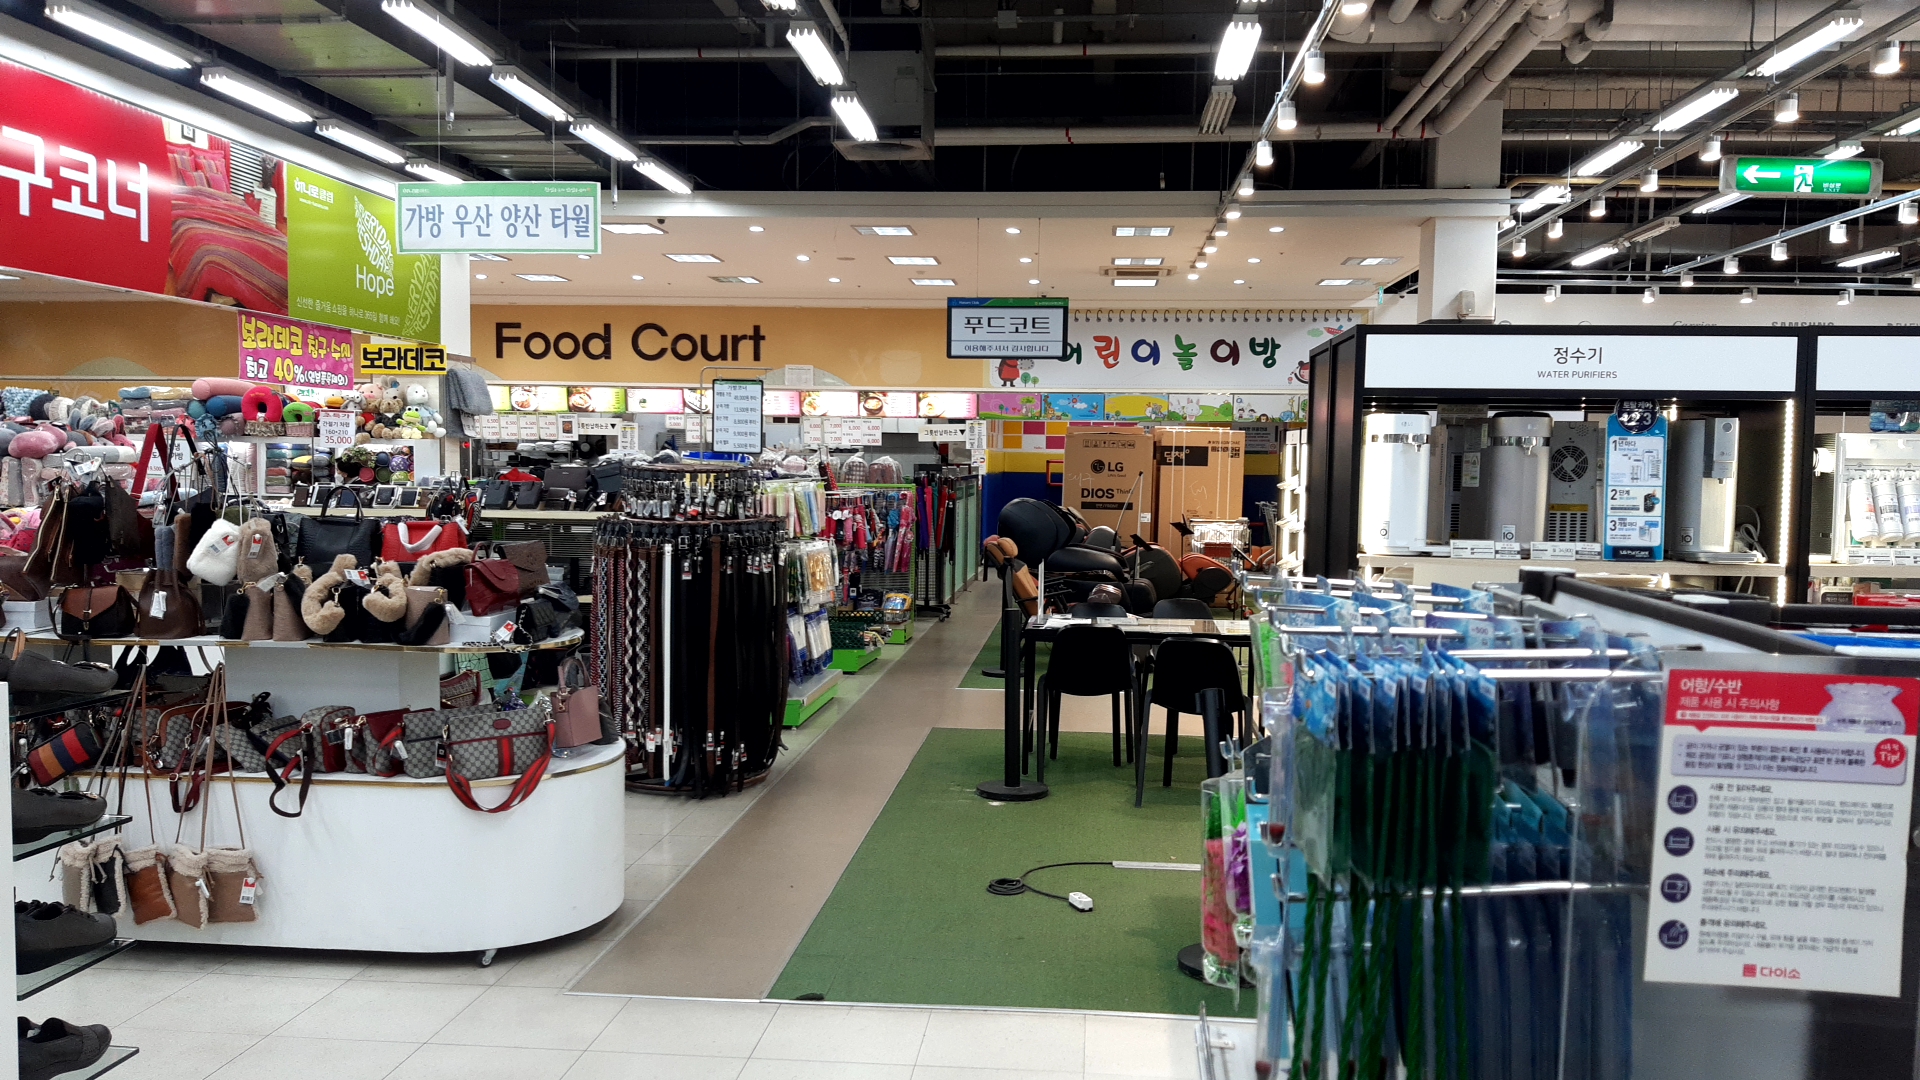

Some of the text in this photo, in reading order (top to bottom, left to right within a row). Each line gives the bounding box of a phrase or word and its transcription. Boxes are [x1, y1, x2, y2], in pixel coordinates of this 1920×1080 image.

[0, 125, 149, 242] 구코너
[404, 203, 591, 238] 가방 우산 양산 타월
[356, 264, 394, 298] Hope
[964, 316, 1050, 335] 푸드코트
[241, 314, 303, 356] 보라데코
[495, 322, 766, 362] Food Court
[964, 344, 1049, 353] 이용해주셔서 감사합니다
[1553, 346, 1603, 365] 정수기
[360, 346, 446, 371] 보라데코
[245, 356, 269, 379] 최고
[1537, 370, 1618, 379] WATER PURIFIERS
[324, 435, 352, 444] 35,000
[924, 429, 958, 437] 그릇반납하는곳
[1107, 461, 1124, 472] LG
[1081, 487, 1115, 499] DIOS
[1680, 678, 1742, 695] 어항/수반
[1680, 696, 1780, 711] 제품 사용 시 주의사항
[1880, 751, 1901, 764] Tip!
[1760, 966, 1802, 981] 다이소
